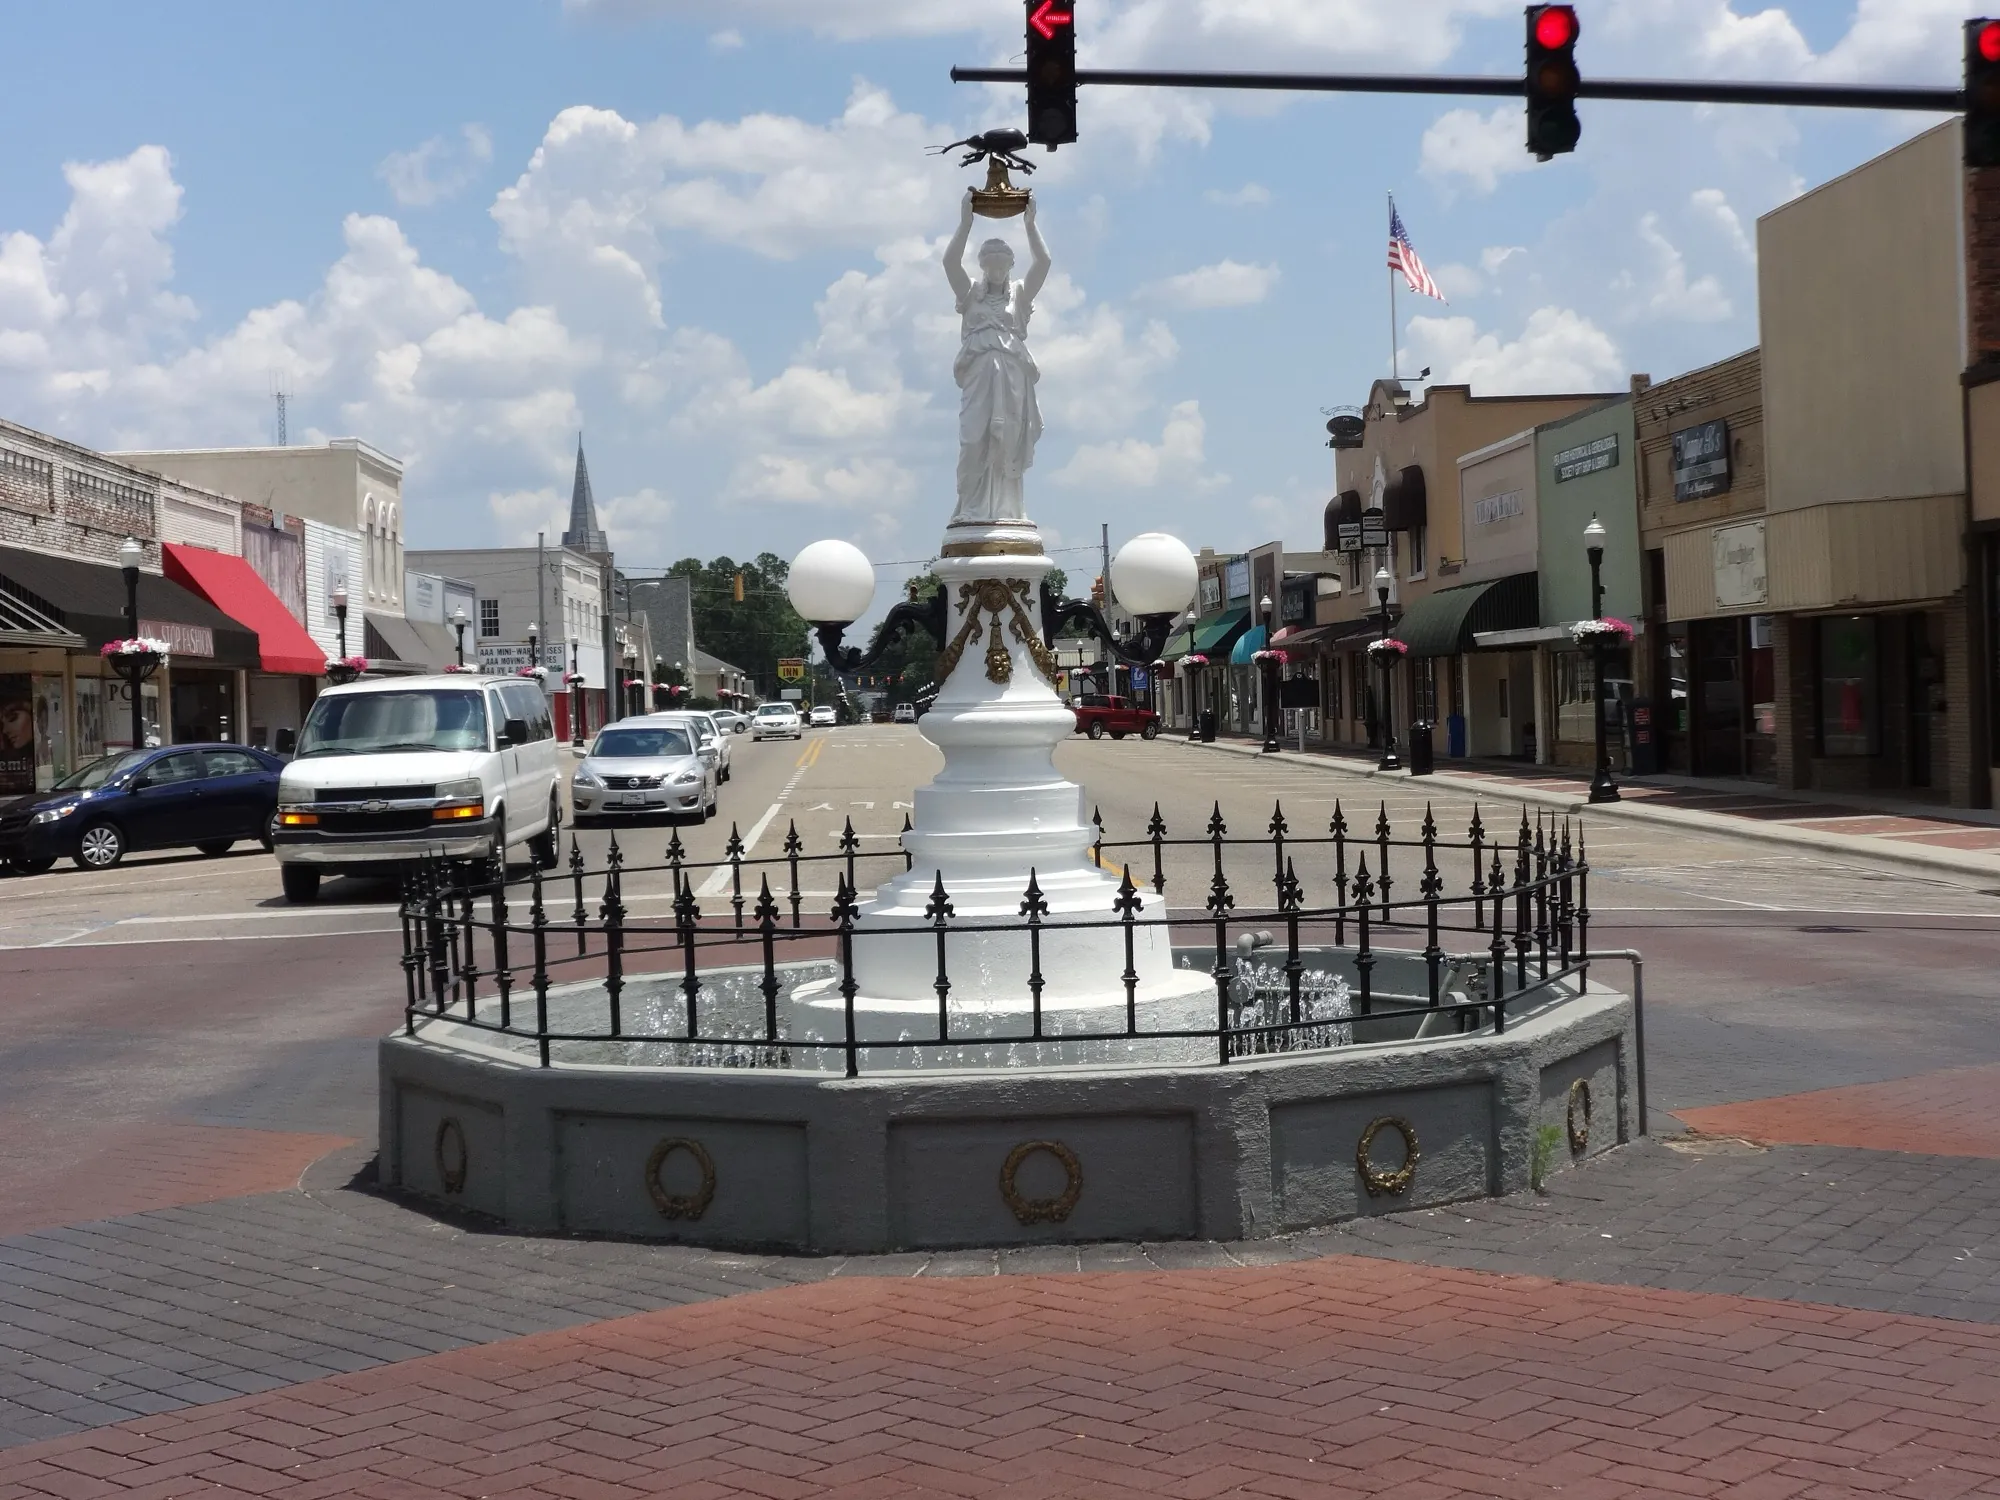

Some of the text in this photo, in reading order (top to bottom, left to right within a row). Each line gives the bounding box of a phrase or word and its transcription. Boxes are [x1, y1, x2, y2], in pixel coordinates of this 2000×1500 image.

[161, 625, 181, 653] STOP
[182, 627, 214, 656] FASHION
[480, 648, 494, 656] AAA
[501, 656, 525, 665] MOVING
